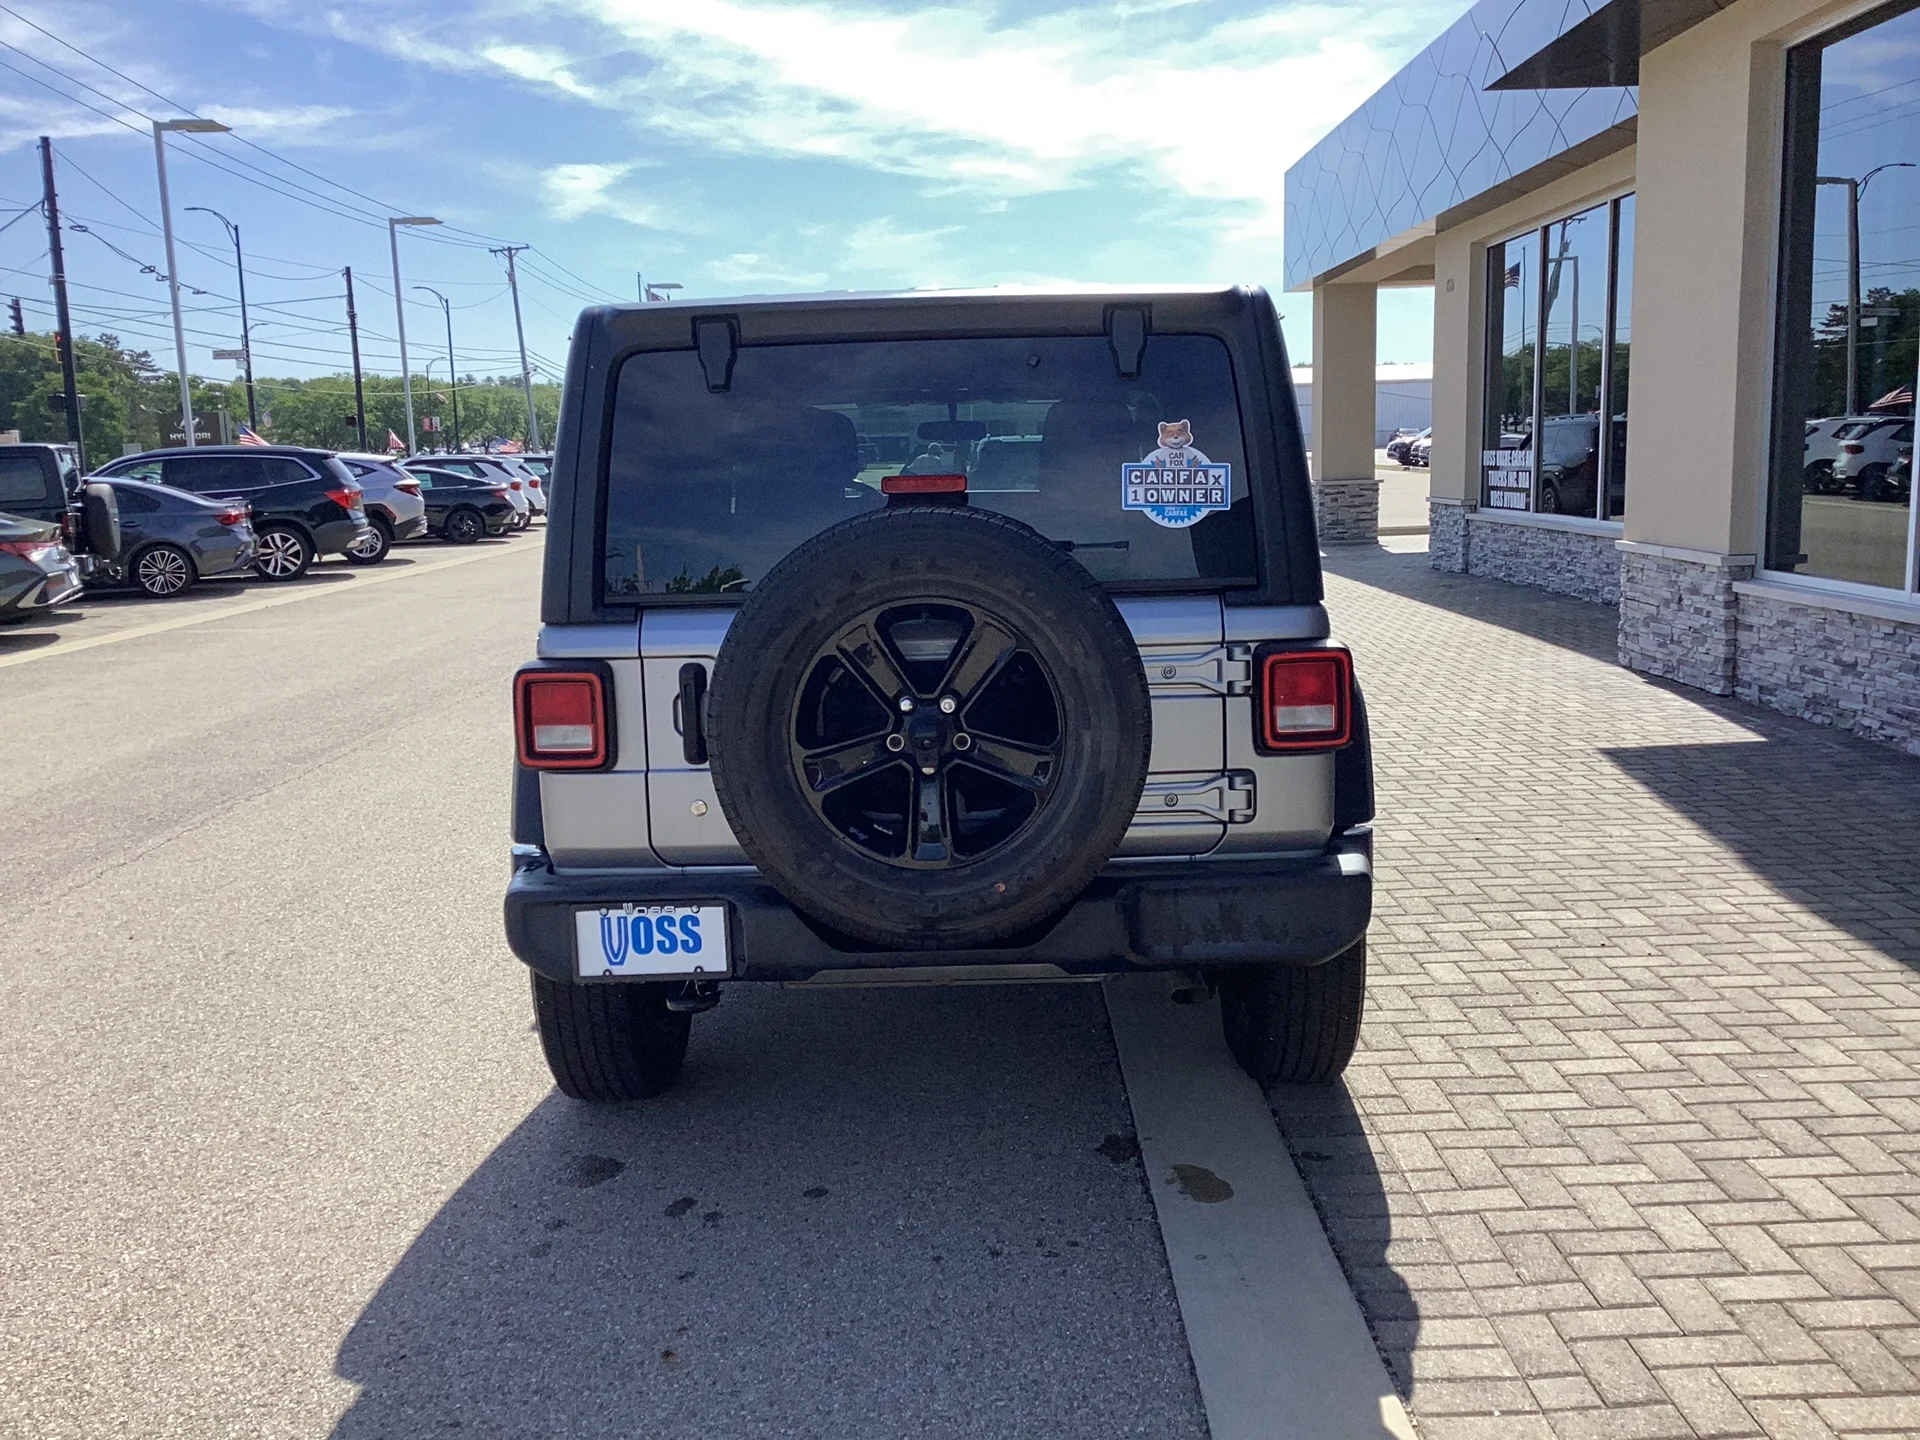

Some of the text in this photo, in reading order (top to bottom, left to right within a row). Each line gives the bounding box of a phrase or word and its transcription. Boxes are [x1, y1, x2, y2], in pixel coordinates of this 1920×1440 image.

[1130, 470, 1223, 486] CARFAX
[1131, 489, 1223, 503] 1 OWNER
[600, 915, 702, 966] VOSS
